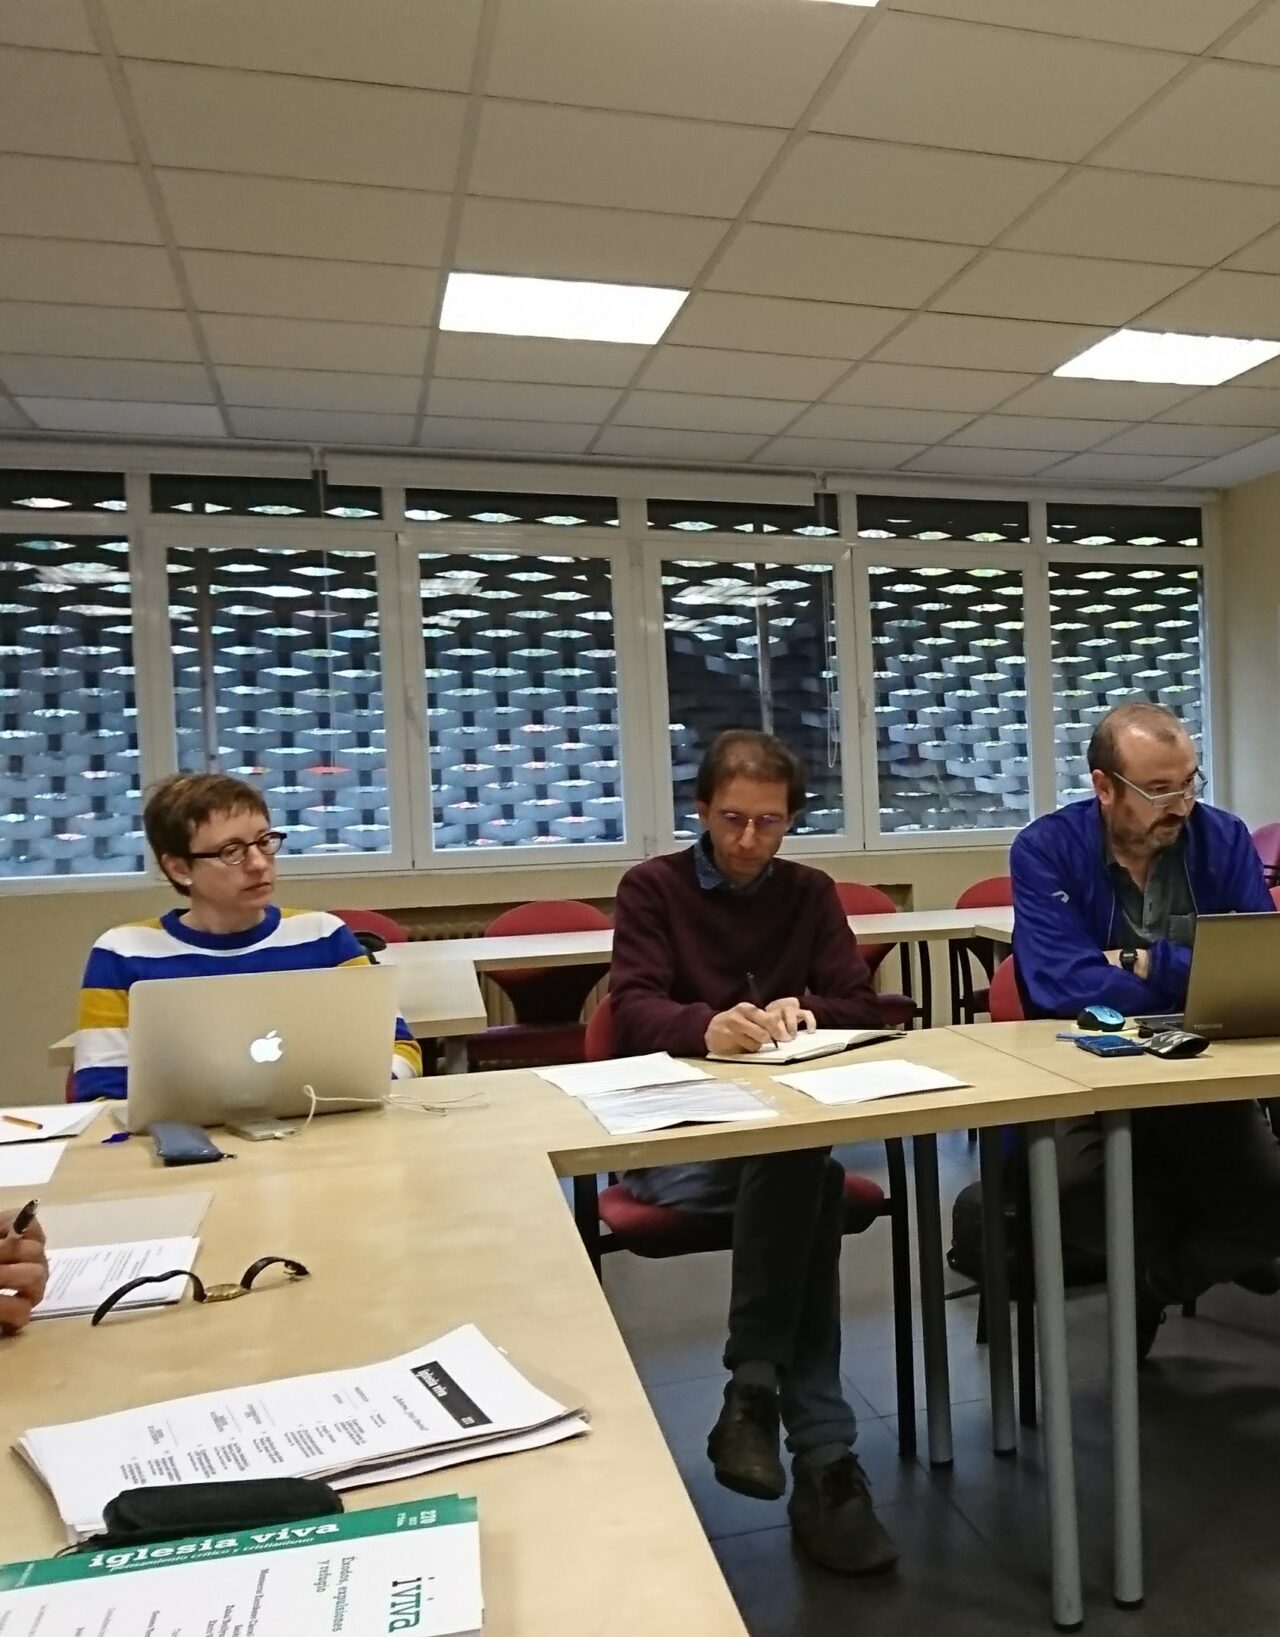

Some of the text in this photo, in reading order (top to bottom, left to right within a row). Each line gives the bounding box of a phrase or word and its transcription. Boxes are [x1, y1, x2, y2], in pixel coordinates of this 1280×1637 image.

[88, 1523, 340, 1569] iglesia viva
[313, 1565, 330, 1594] refugio
[332, 1586, 350, 1633] expulsiones
[387, 1575, 436, 1633] iviva
